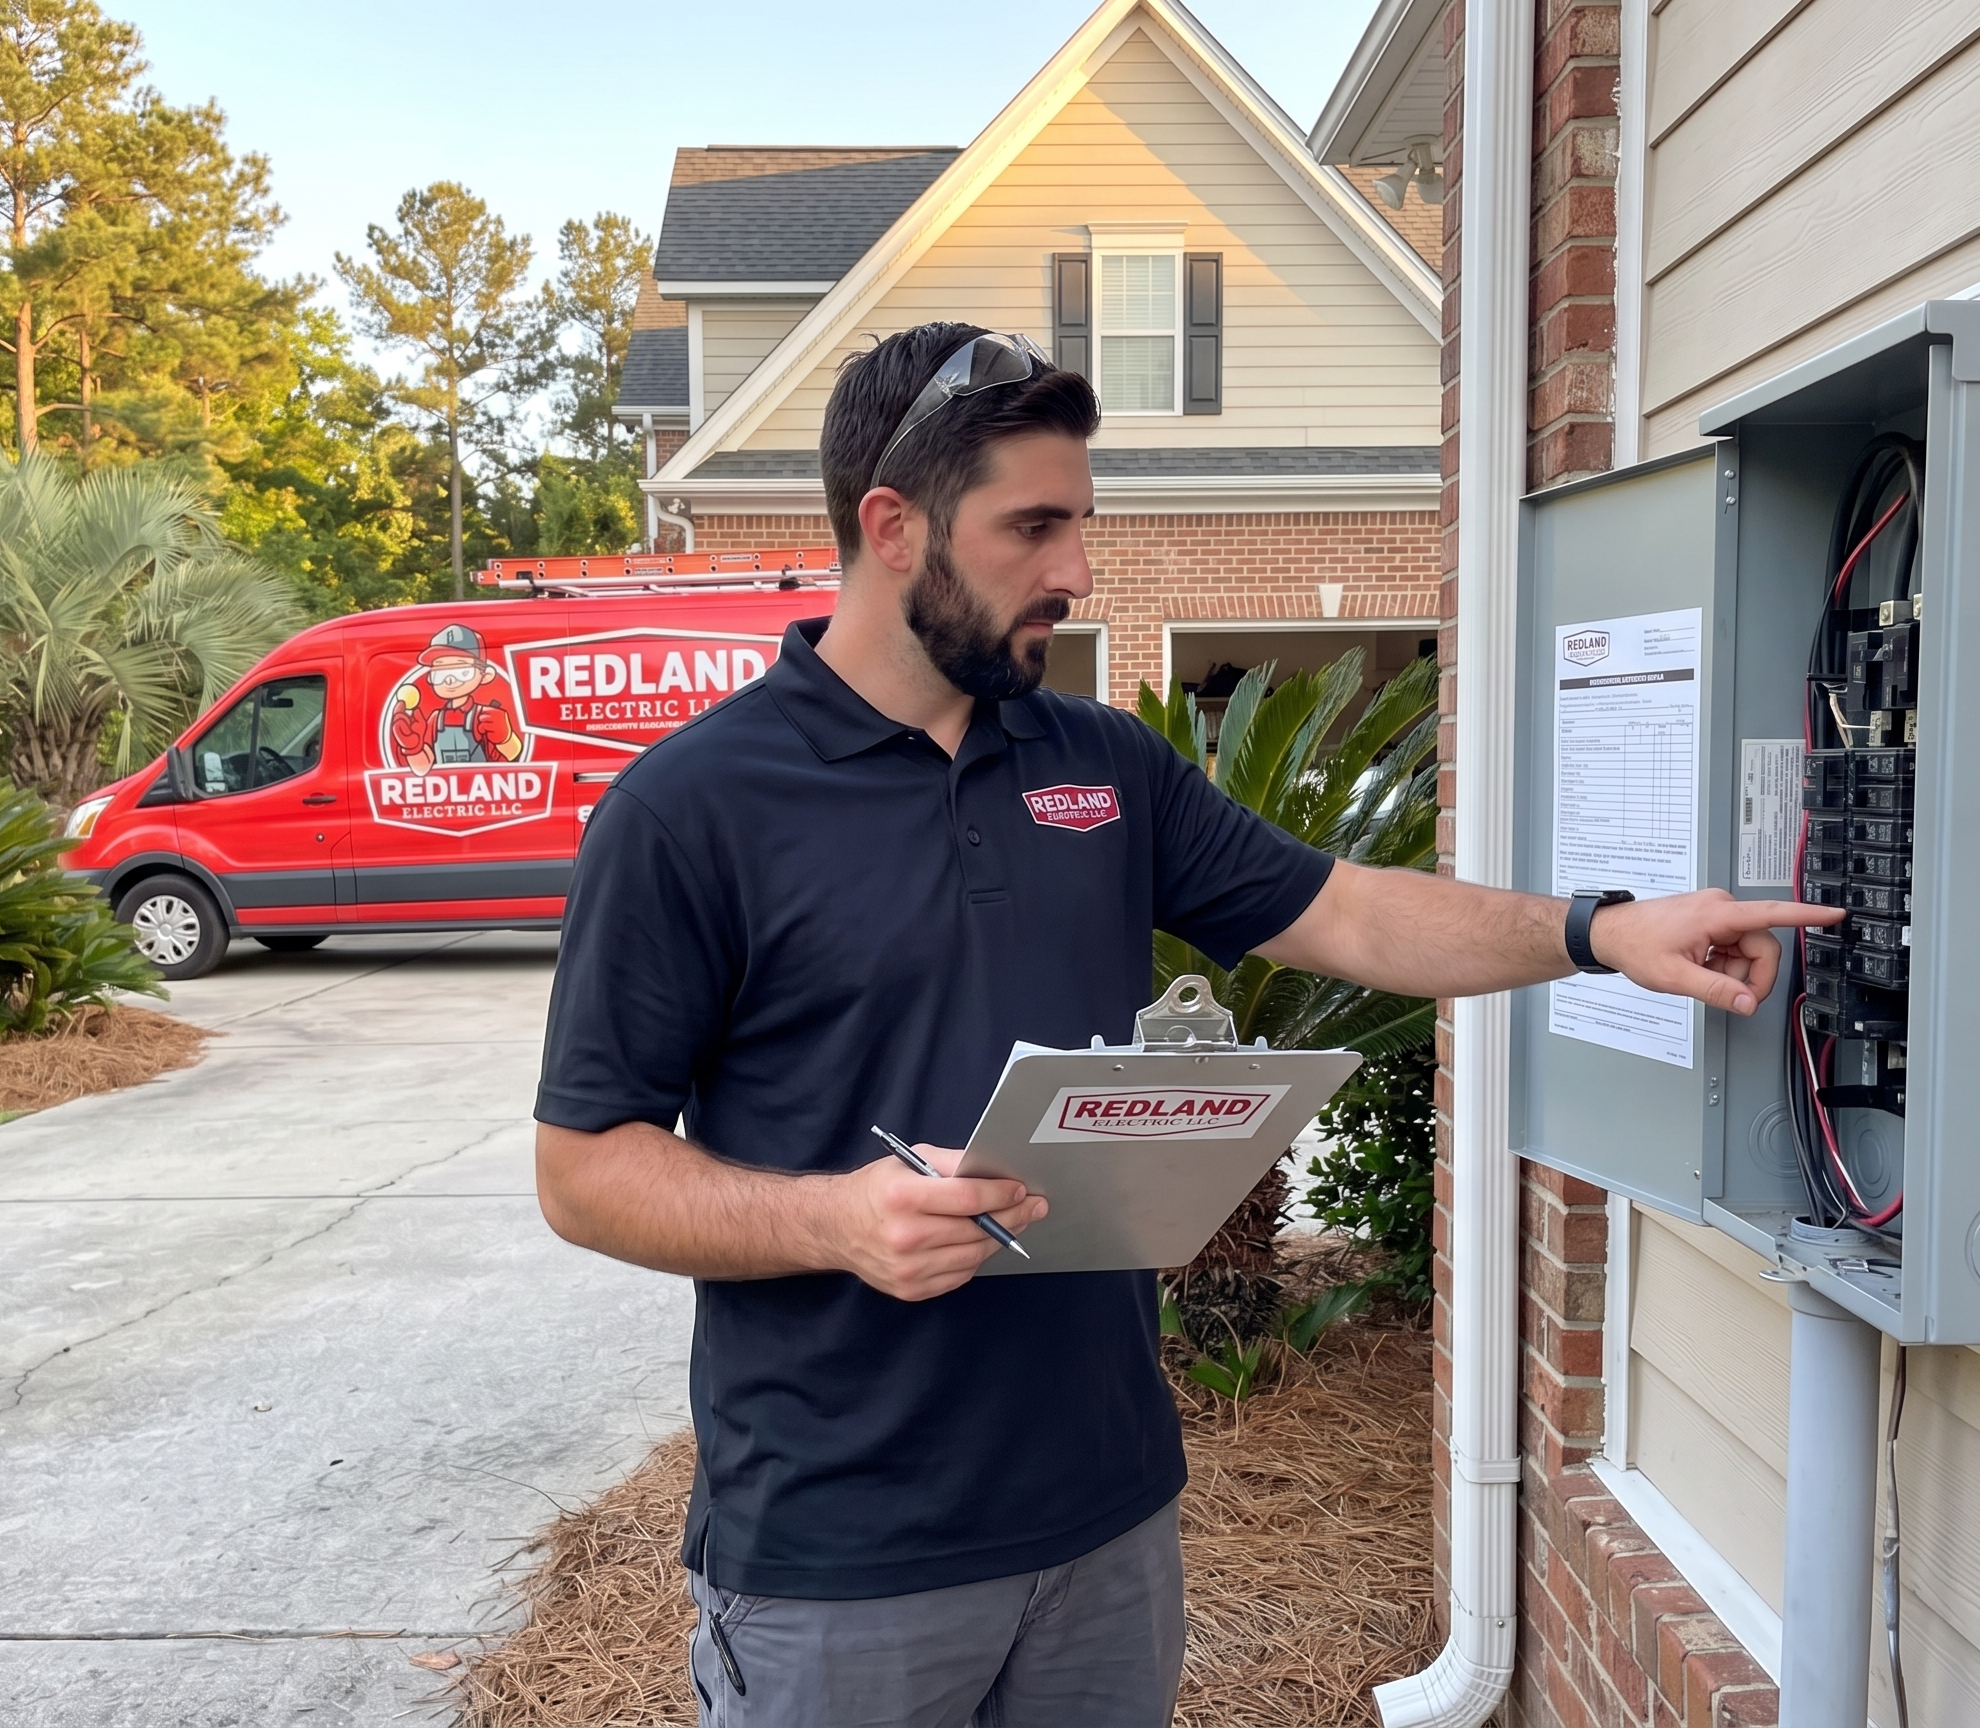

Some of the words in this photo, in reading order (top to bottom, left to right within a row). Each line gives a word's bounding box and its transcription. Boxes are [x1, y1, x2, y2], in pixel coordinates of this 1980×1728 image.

[1567, 636, 1607, 651] REDLAND
[529, 649, 766, 698] REDLAND
[560, 699, 679, 721] ELECTRIC
[380, 772, 542, 805] REDLAND
[402, 804, 486, 819] ELECTRIC
[490, 802, 523, 816] LLC
[1030, 792, 1112, 813] REDLAND
[1073, 1098, 1252, 1119] REDLAND
[1091, 1118, 1183, 1127] ELECTRIC
[1186, 1117, 1220, 1126] LLC
